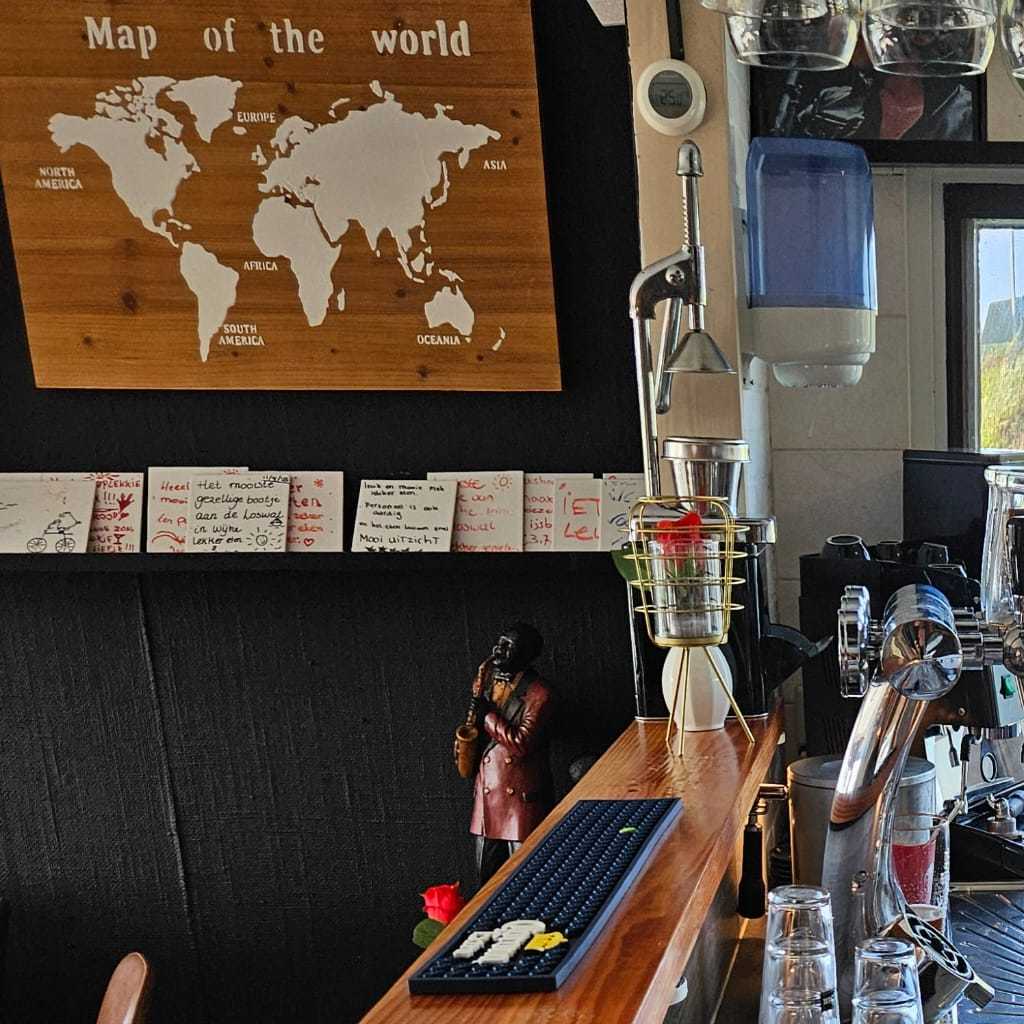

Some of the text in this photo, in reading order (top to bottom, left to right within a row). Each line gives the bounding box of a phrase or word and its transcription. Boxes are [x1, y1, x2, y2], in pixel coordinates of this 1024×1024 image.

[84, 16, 471, 58] Map of the world
[236, 111, 277, 124] EUROPE
[483, 160, 508, 171] ASIA
[39, 166, 76, 178] NORTH
[35, 178, 83, 190] AMERICA
[243, 261, 279, 272] AFRICA
[223, 323, 258, 335] SOUTH
[218, 334, 266, 347] AMERICA
[416, 334, 461, 346] OCEANIA
[195, 511, 218, 520] aan
[224, 511, 239, 520] de
